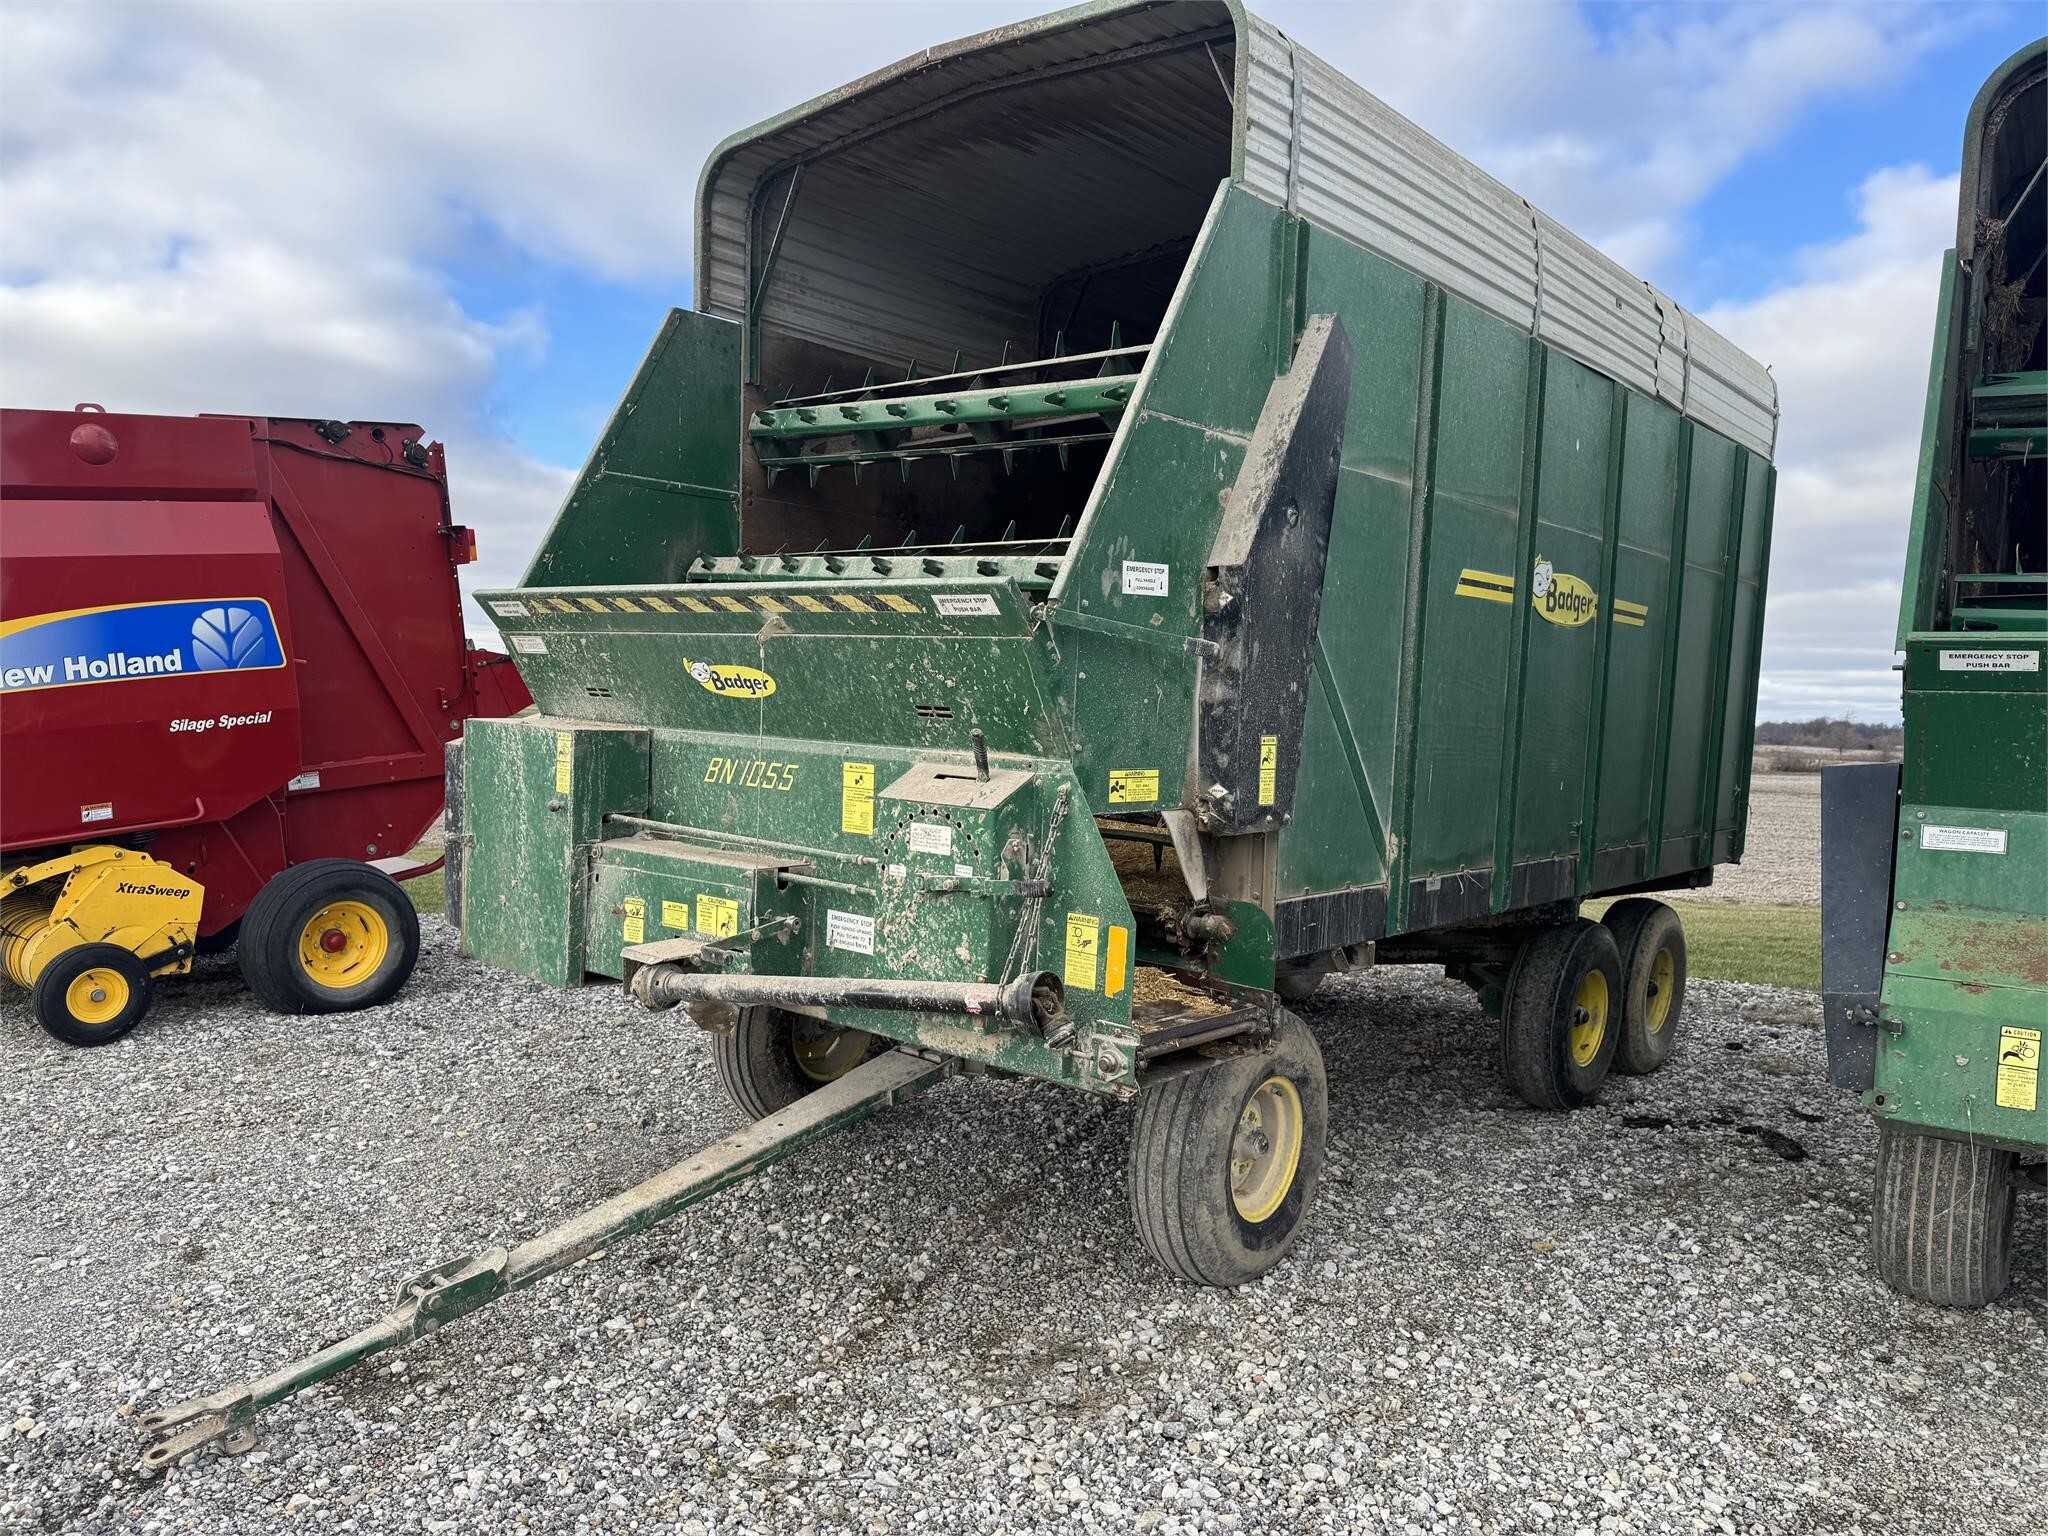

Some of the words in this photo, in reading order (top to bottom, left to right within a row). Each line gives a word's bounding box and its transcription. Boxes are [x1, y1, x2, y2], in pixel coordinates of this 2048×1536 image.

[1126, 565, 1153, 574] EMERGENCY
[1154, 567, 1165, 575] STOP
[1545, 578, 1593, 622] Badger
[63, 648, 182, 681] Holland
[709, 670, 769, 696] Badger
[169, 717, 215, 733] Silage
[218, 711, 272, 729] Special
[115, 882, 191, 900] XtraSweep
[707, 897, 727, 906] CAUTION
[831, 914, 860, 925] EMERGENCY
[860, 920, 873, 928] STOP
[2013, 1029, 2037, 1038] CAUTION
